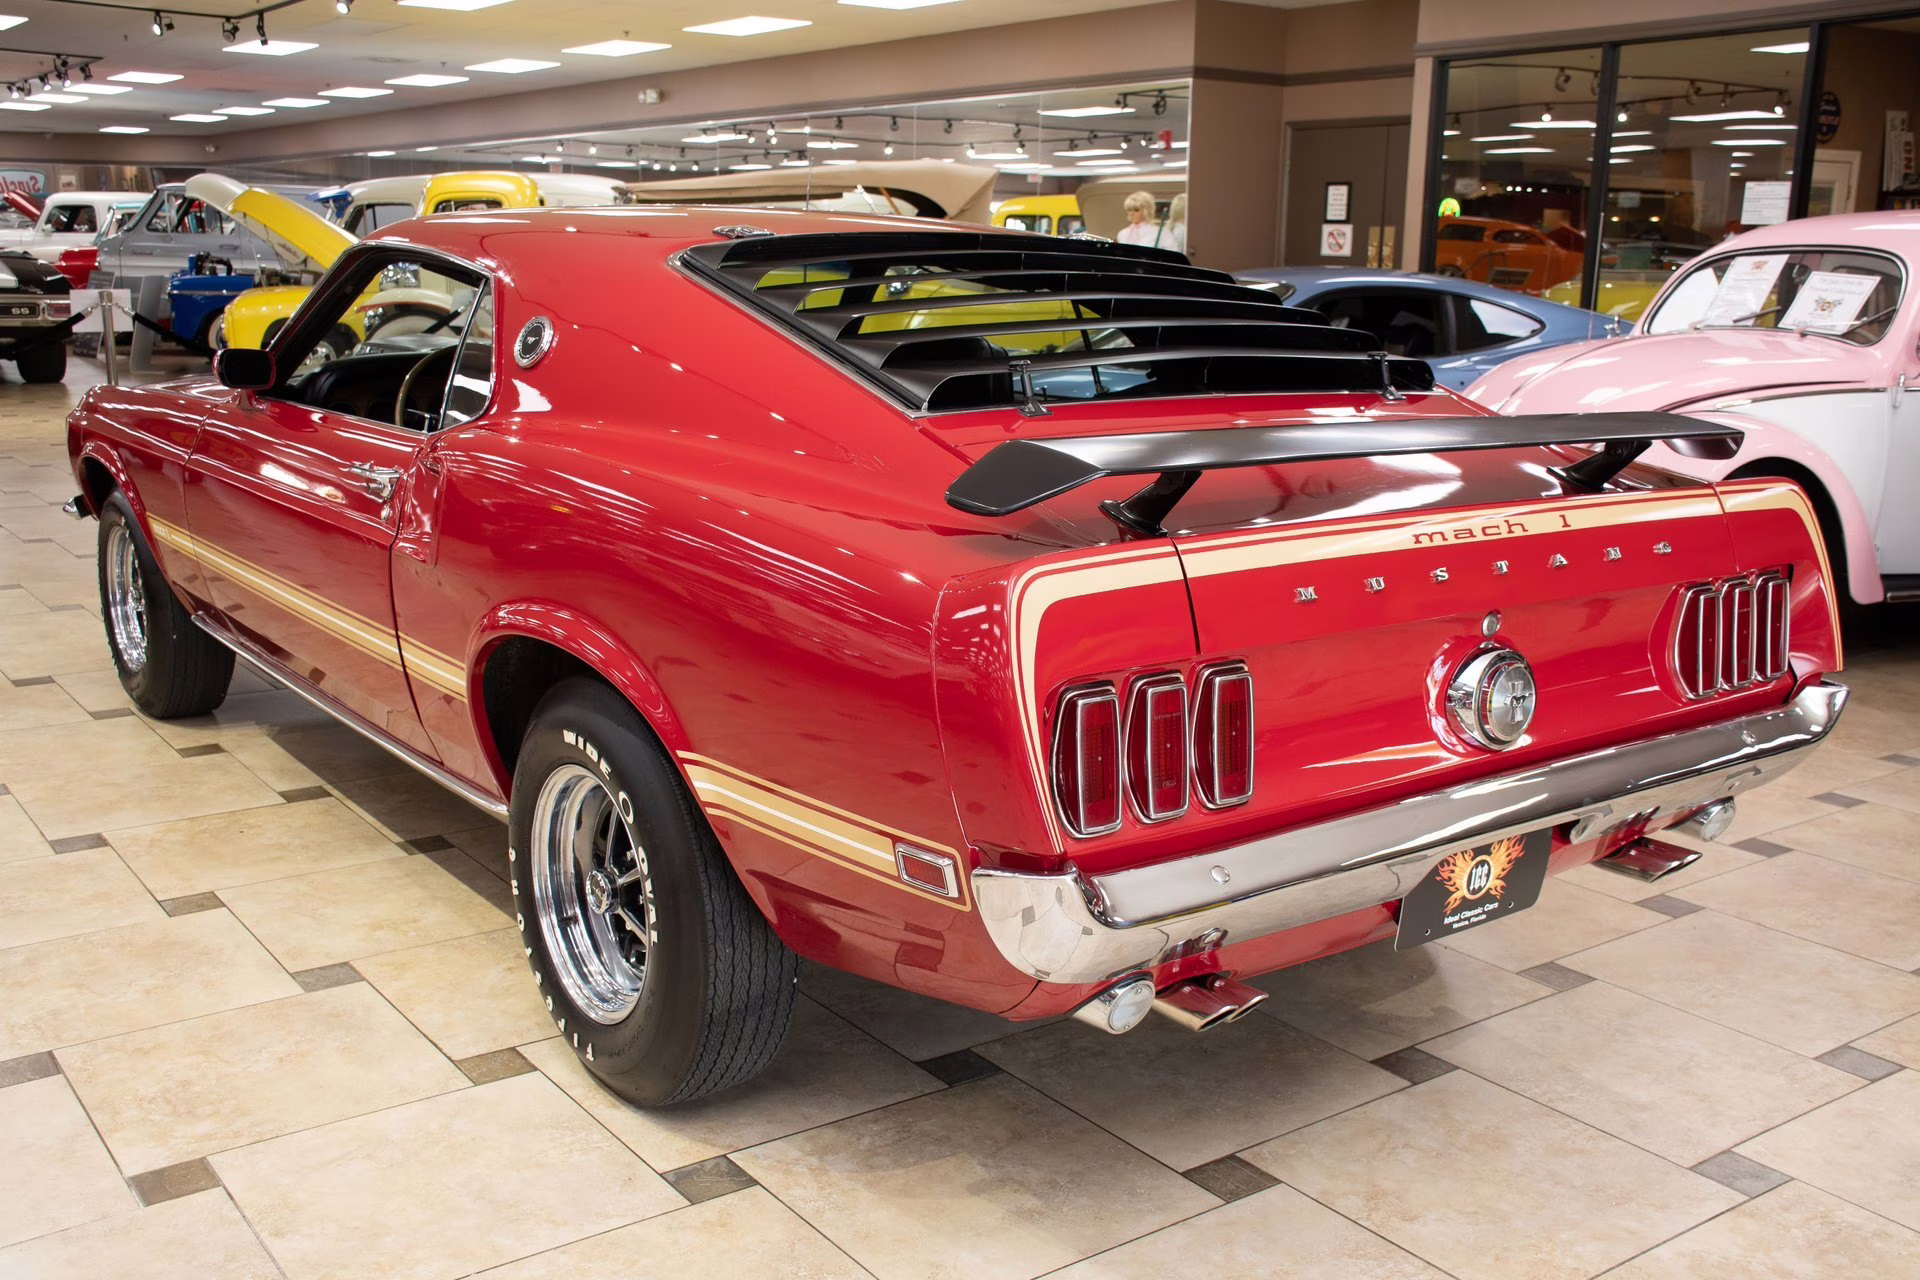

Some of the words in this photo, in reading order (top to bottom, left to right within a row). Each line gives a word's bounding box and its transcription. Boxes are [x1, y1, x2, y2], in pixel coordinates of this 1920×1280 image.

[11, 307, 30, 315] SS
[1413, 519, 1529, 545] mach
[1559, 514, 1572, 529] 1
[1294, 541, 1673, 603] MUSTANG
[562, 728, 612, 781] WIDE
[1443, 913, 1460, 925] Ideal
[1461, 907, 1483, 919] Classic
[1484, 902, 1499, 911] Cars
[1469, 914, 1487, 923] Florida
